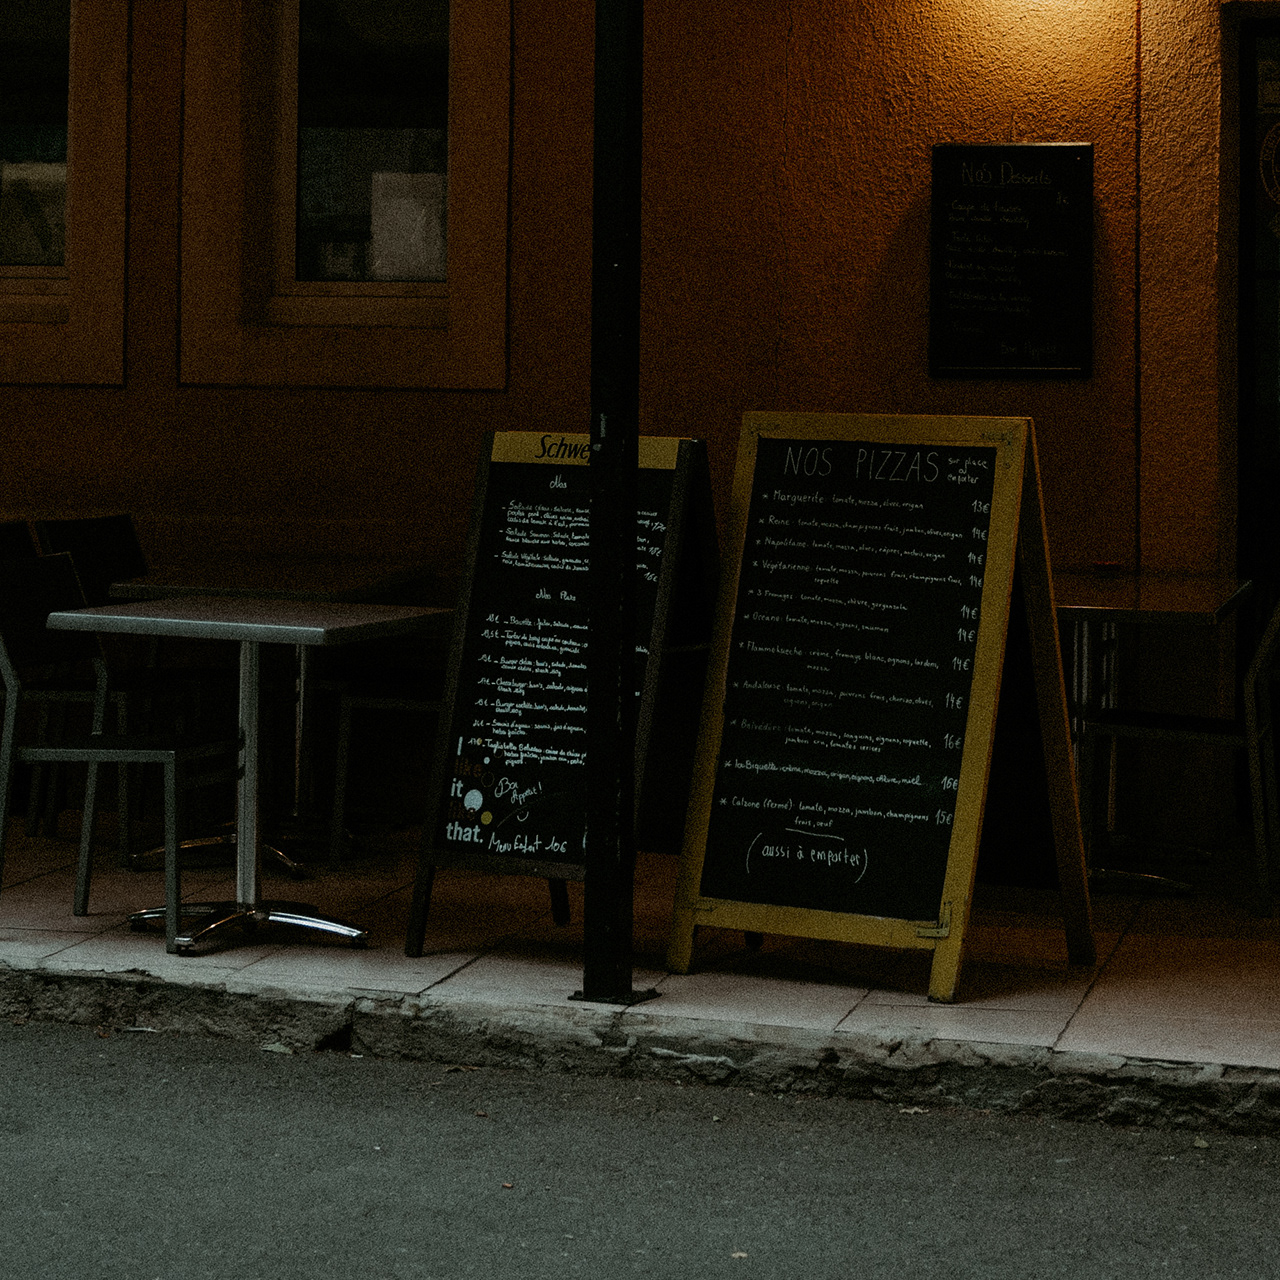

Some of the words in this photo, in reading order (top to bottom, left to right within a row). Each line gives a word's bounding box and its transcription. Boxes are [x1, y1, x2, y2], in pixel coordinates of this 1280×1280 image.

[535, 435, 590, 461] Schwe
[783, 446, 833, 477] NOS
[856, 447, 939, 483] PIZZAS
[971, 499, 991, 514] 13€
[972, 526, 988, 541] 14€
[967, 551, 985, 565] 14€
[960, 604, 978, 620] 14€
[957, 627, 976, 643] 14€
[952, 656, 971, 671] 14€
[945, 692, 964, 710] 14€
[943, 732, 962, 750] 16€
[450, 777, 464, 798] it
[940, 775, 959, 791] 16€
[732, 795, 760, 809] Calzone
[934, 808, 953, 825] 15€
[445, 821, 484, 843] that.
[796, 843, 804, 860] à
